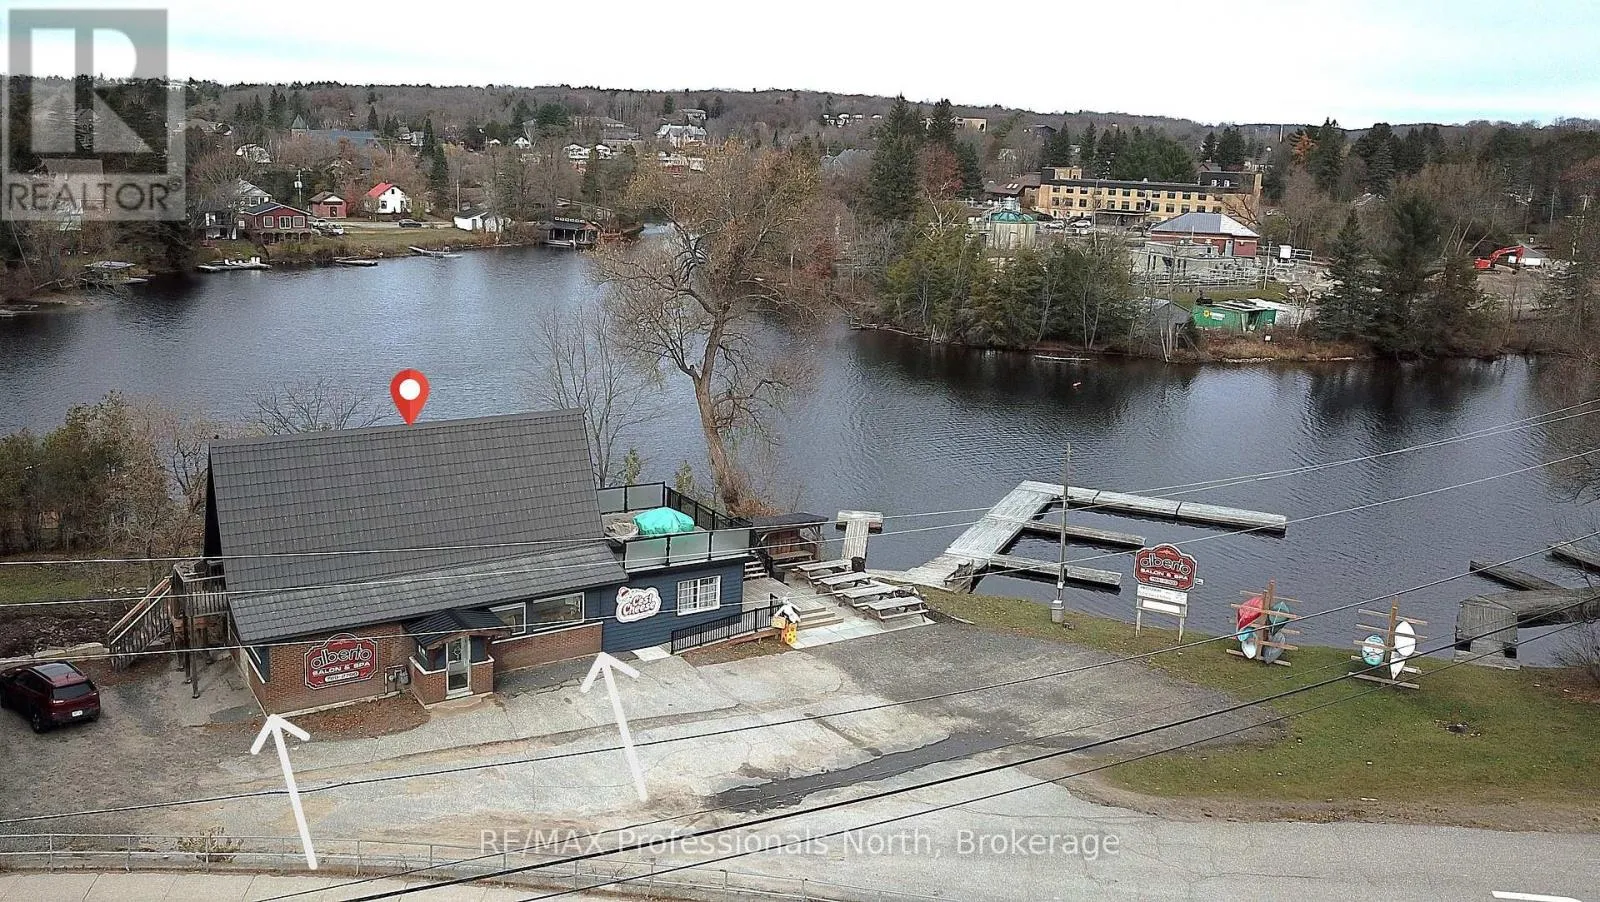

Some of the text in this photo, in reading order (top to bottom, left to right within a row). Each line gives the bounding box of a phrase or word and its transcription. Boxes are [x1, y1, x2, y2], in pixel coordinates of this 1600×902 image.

[1140, 553, 1191, 575] alberto
[1140, 568, 1165, 577] SALON
[621, 600, 657, 617] Cheese
[311, 643, 372, 669] alberto
[312, 666, 342, 677] SALON
[353, 661, 371, 669] SPA
